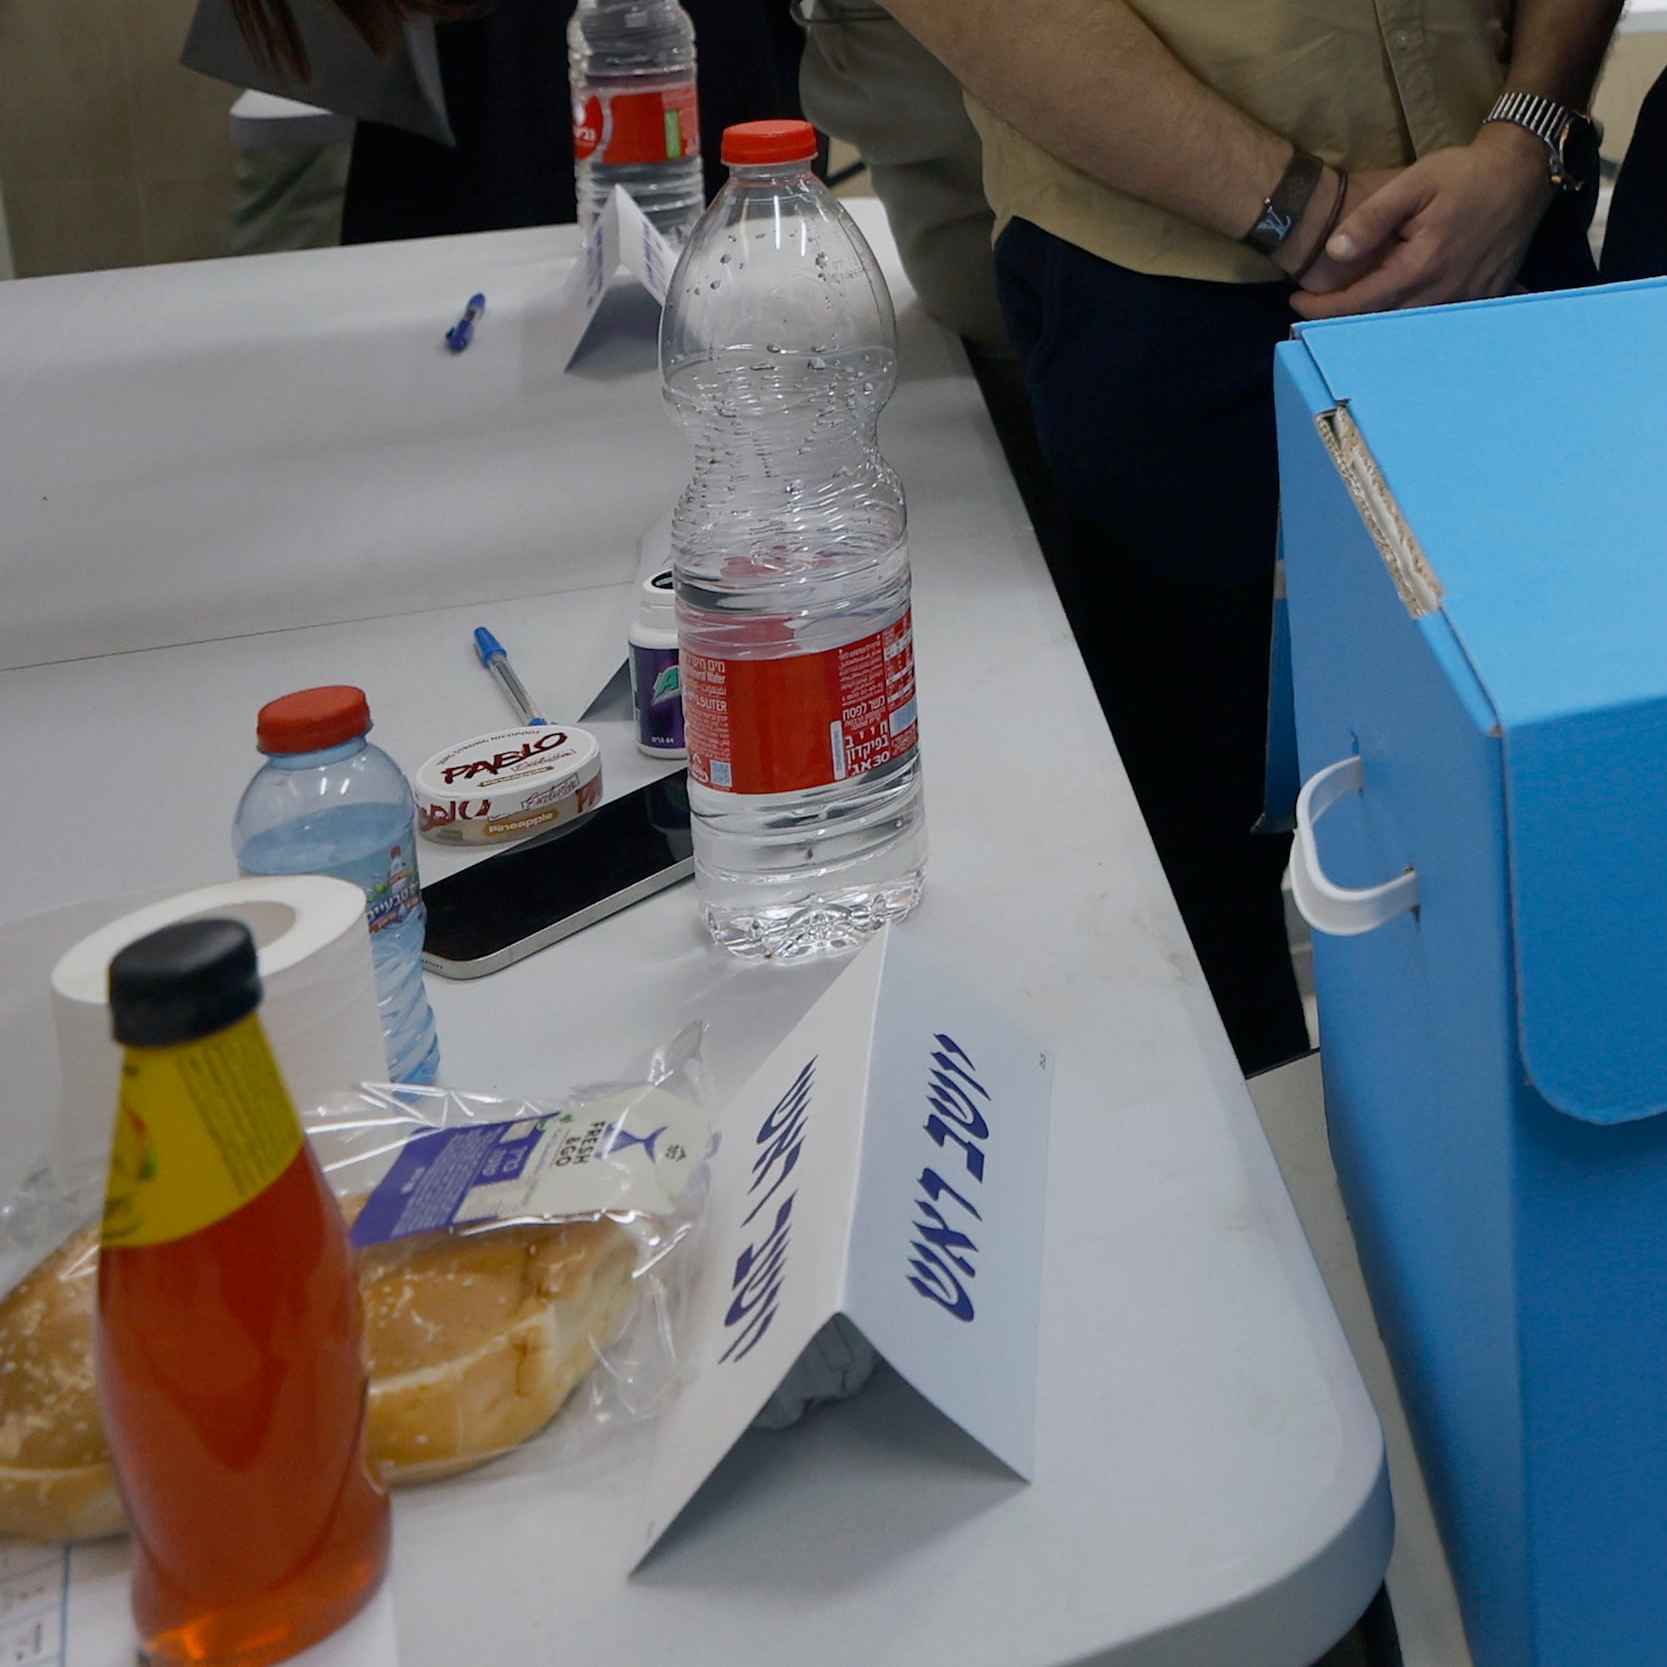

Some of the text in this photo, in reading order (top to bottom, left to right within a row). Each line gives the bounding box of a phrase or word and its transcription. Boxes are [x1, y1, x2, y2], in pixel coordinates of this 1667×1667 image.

[842, 700, 867, 721] לפסח
[867, 695, 885, 712] כשר
[441, 732, 568, 785] PABLO
[846, 735, 889, 765] בפיקדון
[872, 751, 890, 767] 30
[489, 812, 553, 834] Pineapple
[556, 1137, 574, 1167] &GO
[573, 1121, 605, 1164] FRESH
[905, 1034, 991, 1322] יושב ראש
[718, 1054, 819, 1365] יושב ראש
